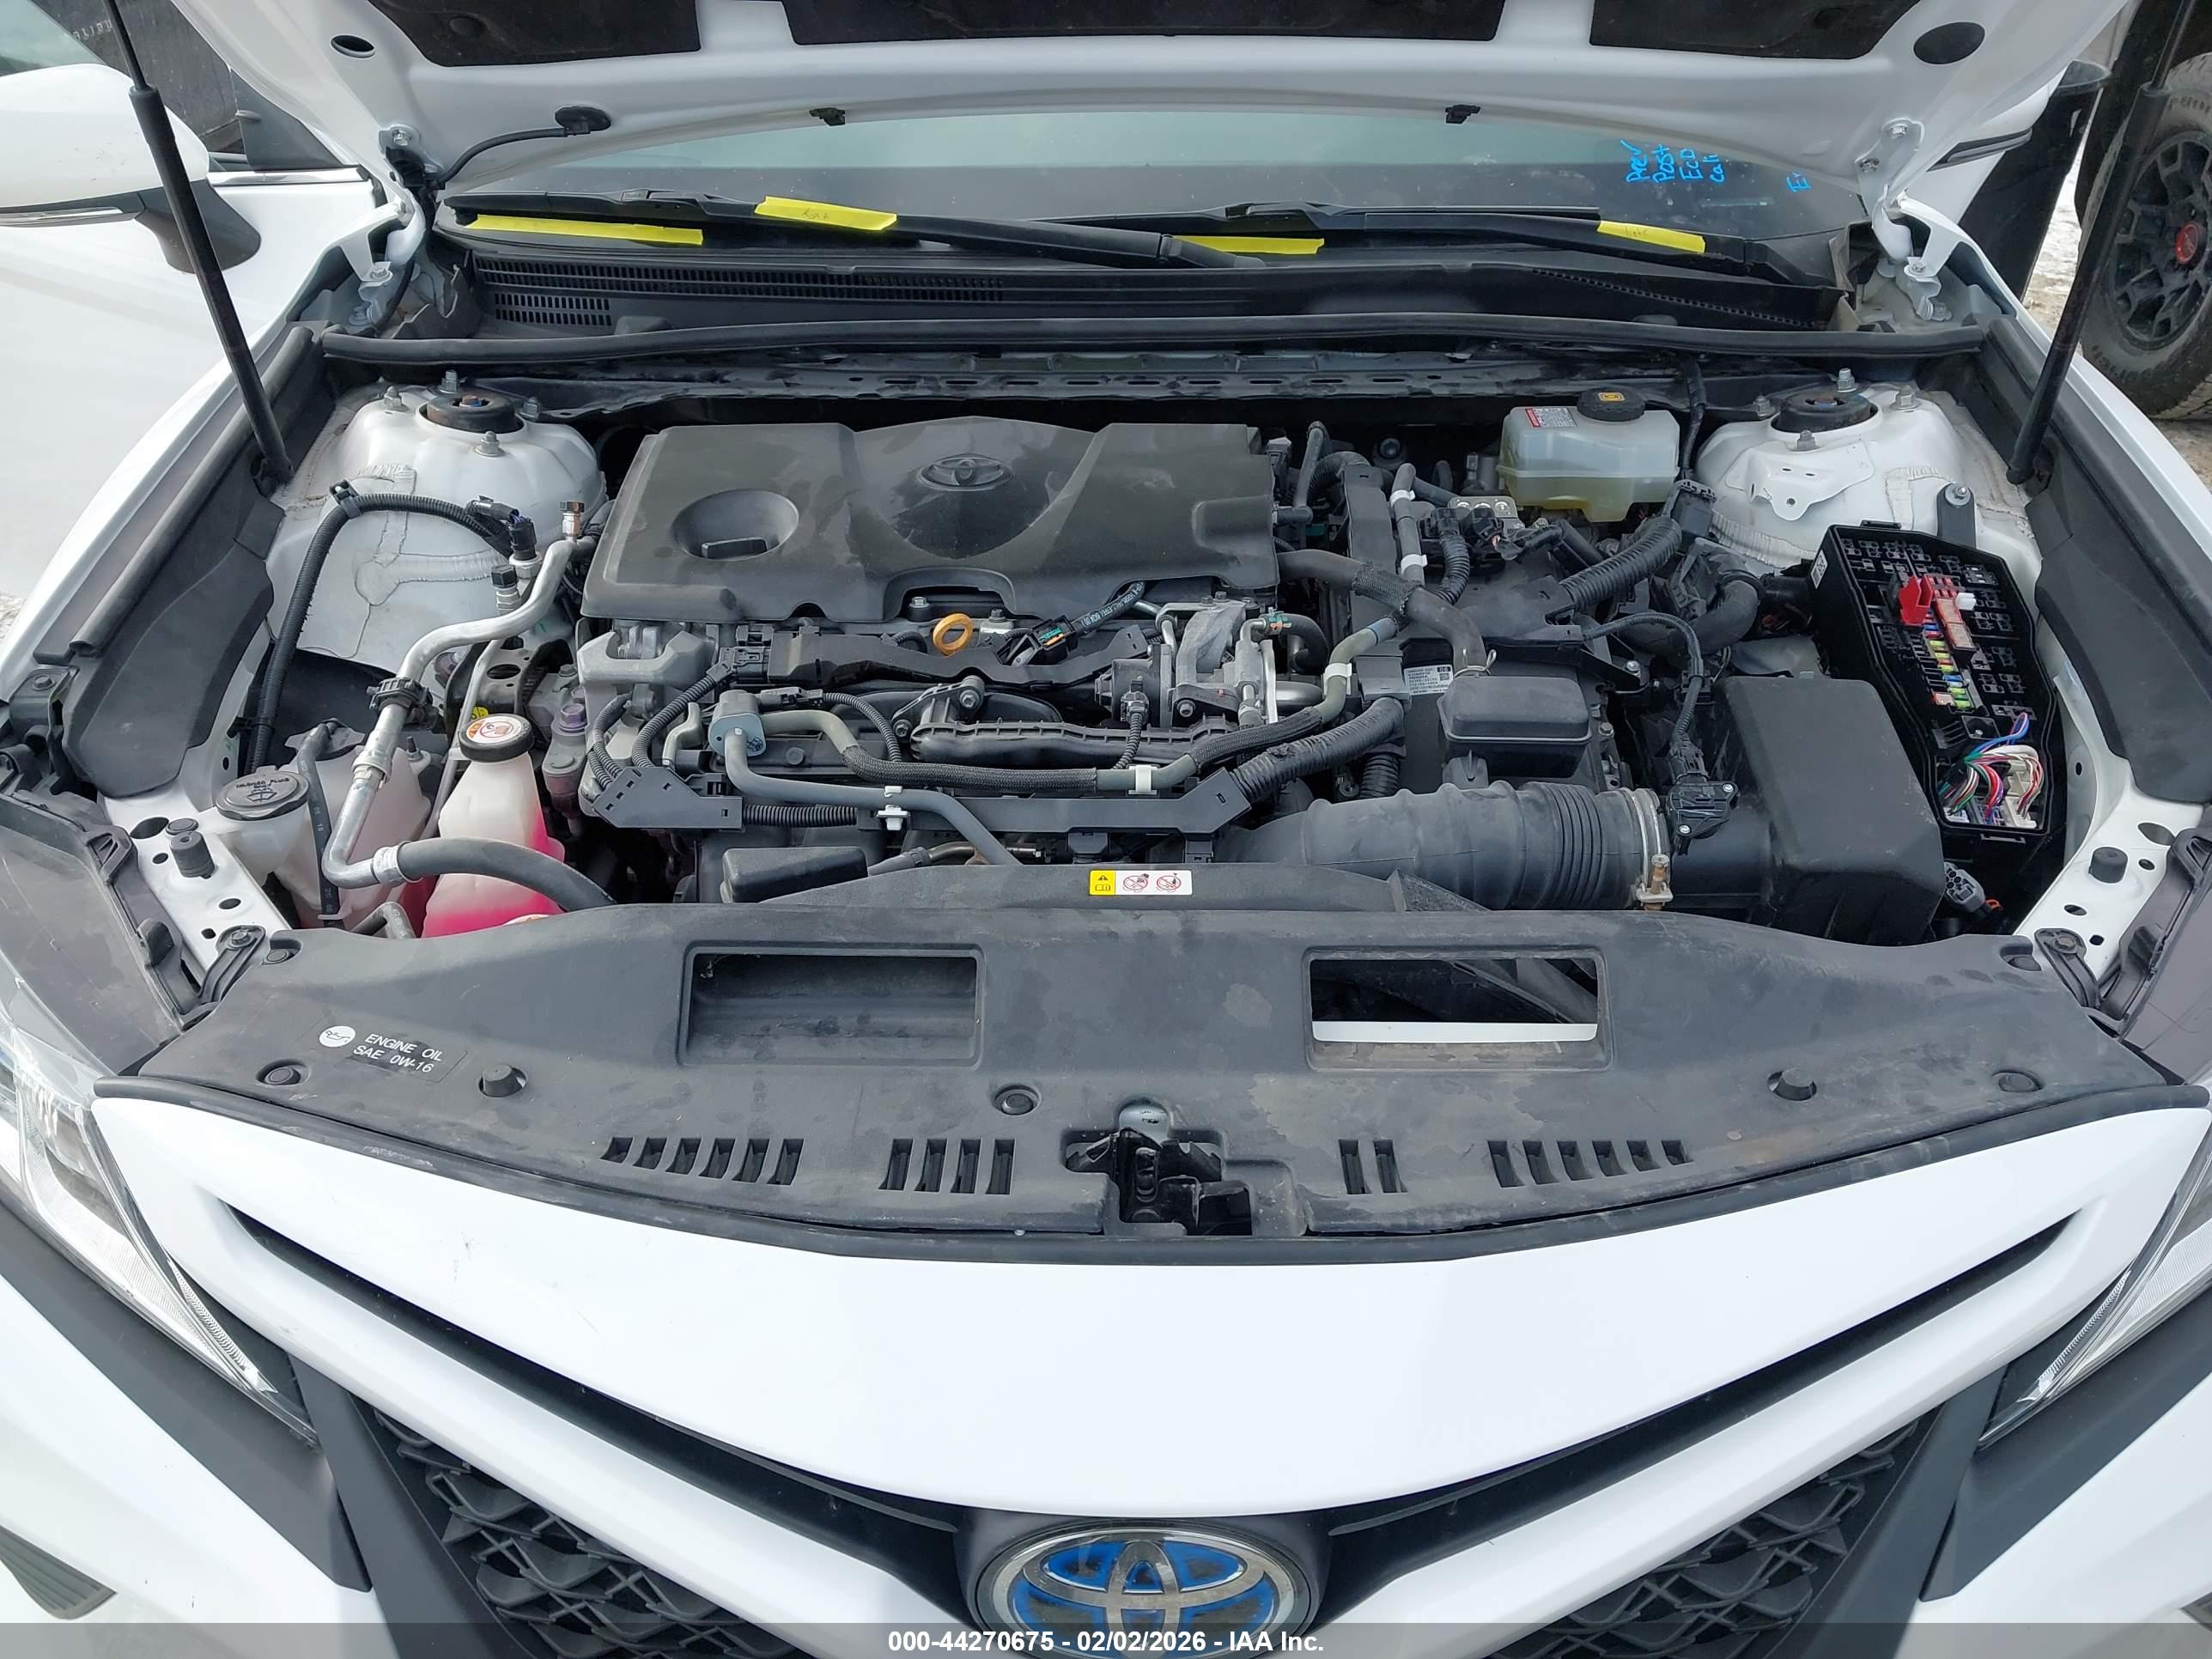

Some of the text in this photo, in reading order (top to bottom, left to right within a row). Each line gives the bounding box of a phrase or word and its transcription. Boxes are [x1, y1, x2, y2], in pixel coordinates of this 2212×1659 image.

[353, 1045, 434, 1073] SAE 0W-16
[365, 1033, 443, 1062] ENGINE OIL
